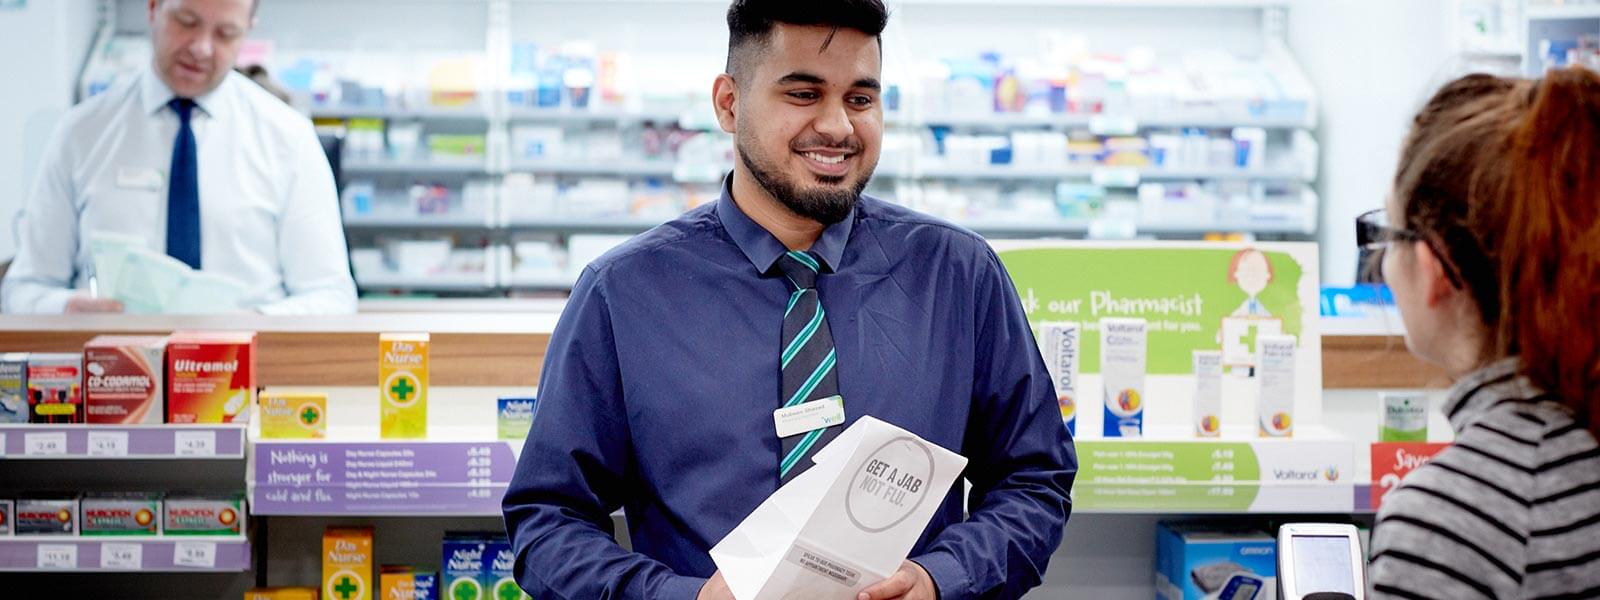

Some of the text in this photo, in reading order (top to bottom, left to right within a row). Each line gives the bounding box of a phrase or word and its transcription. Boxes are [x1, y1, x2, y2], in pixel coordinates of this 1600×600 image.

[1048, 299, 1082, 315] our
[1090, 289, 1203, 316] Pharmacist
[391, 340, 417, 354] Day
[384, 351, 422, 364] Nurse
[1061, 328, 1075, 391] Voltarol
[175, 359, 239, 373] Ultramol
[264, 407, 294, 417] Nurse
[270, 449, 317, 469] Nothing
[267, 468, 331, 488] stronger for
[866, 459, 922, 493] GET A JAB
[1273, 469, 1318, 480] Voltarol
[290, 489, 312, 502] and
[859, 475, 907, 507] NOT FLU.
[86, 508, 130, 518] NUROFEN
[169, 508, 214, 518] NUROFEN
[334, 540, 357, 553] Day
[328, 551, 367, 563] Nurse
[453, 548, 483, 562] Night
[497, 549, 515, 562] Nig
[448, 558, 483, 571] Nurse
